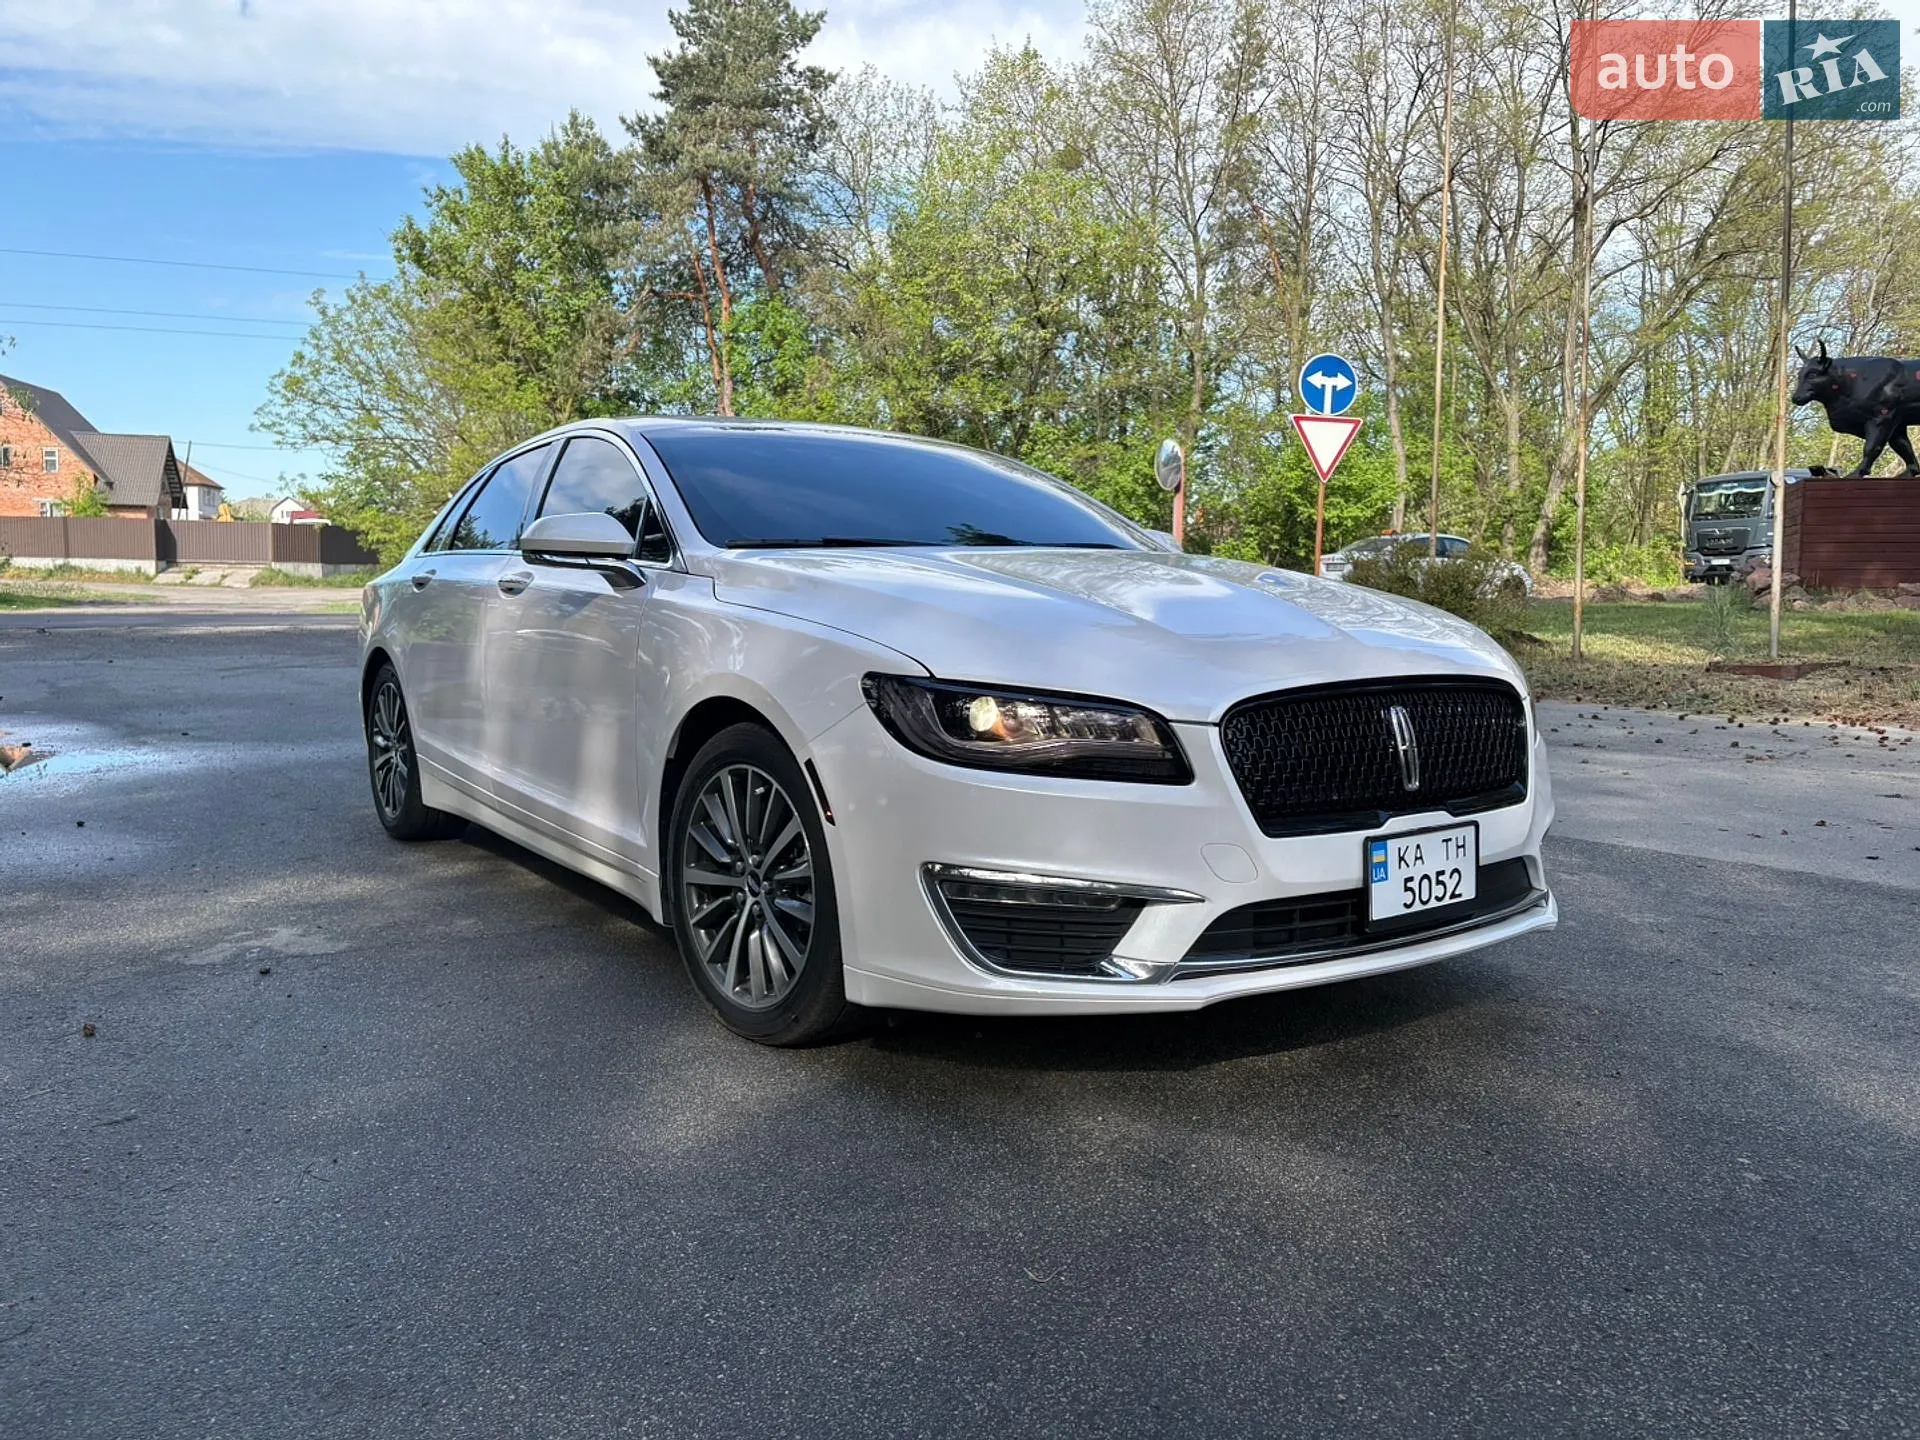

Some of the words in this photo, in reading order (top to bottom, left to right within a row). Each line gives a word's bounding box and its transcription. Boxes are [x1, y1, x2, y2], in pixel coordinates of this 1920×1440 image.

[1398, 843, 1425, 870] KA
[1441, 835, 1467, 861] TH
[1372, 867, 1387, 881] UA
[1403, 868, 1462, 909] 5052
